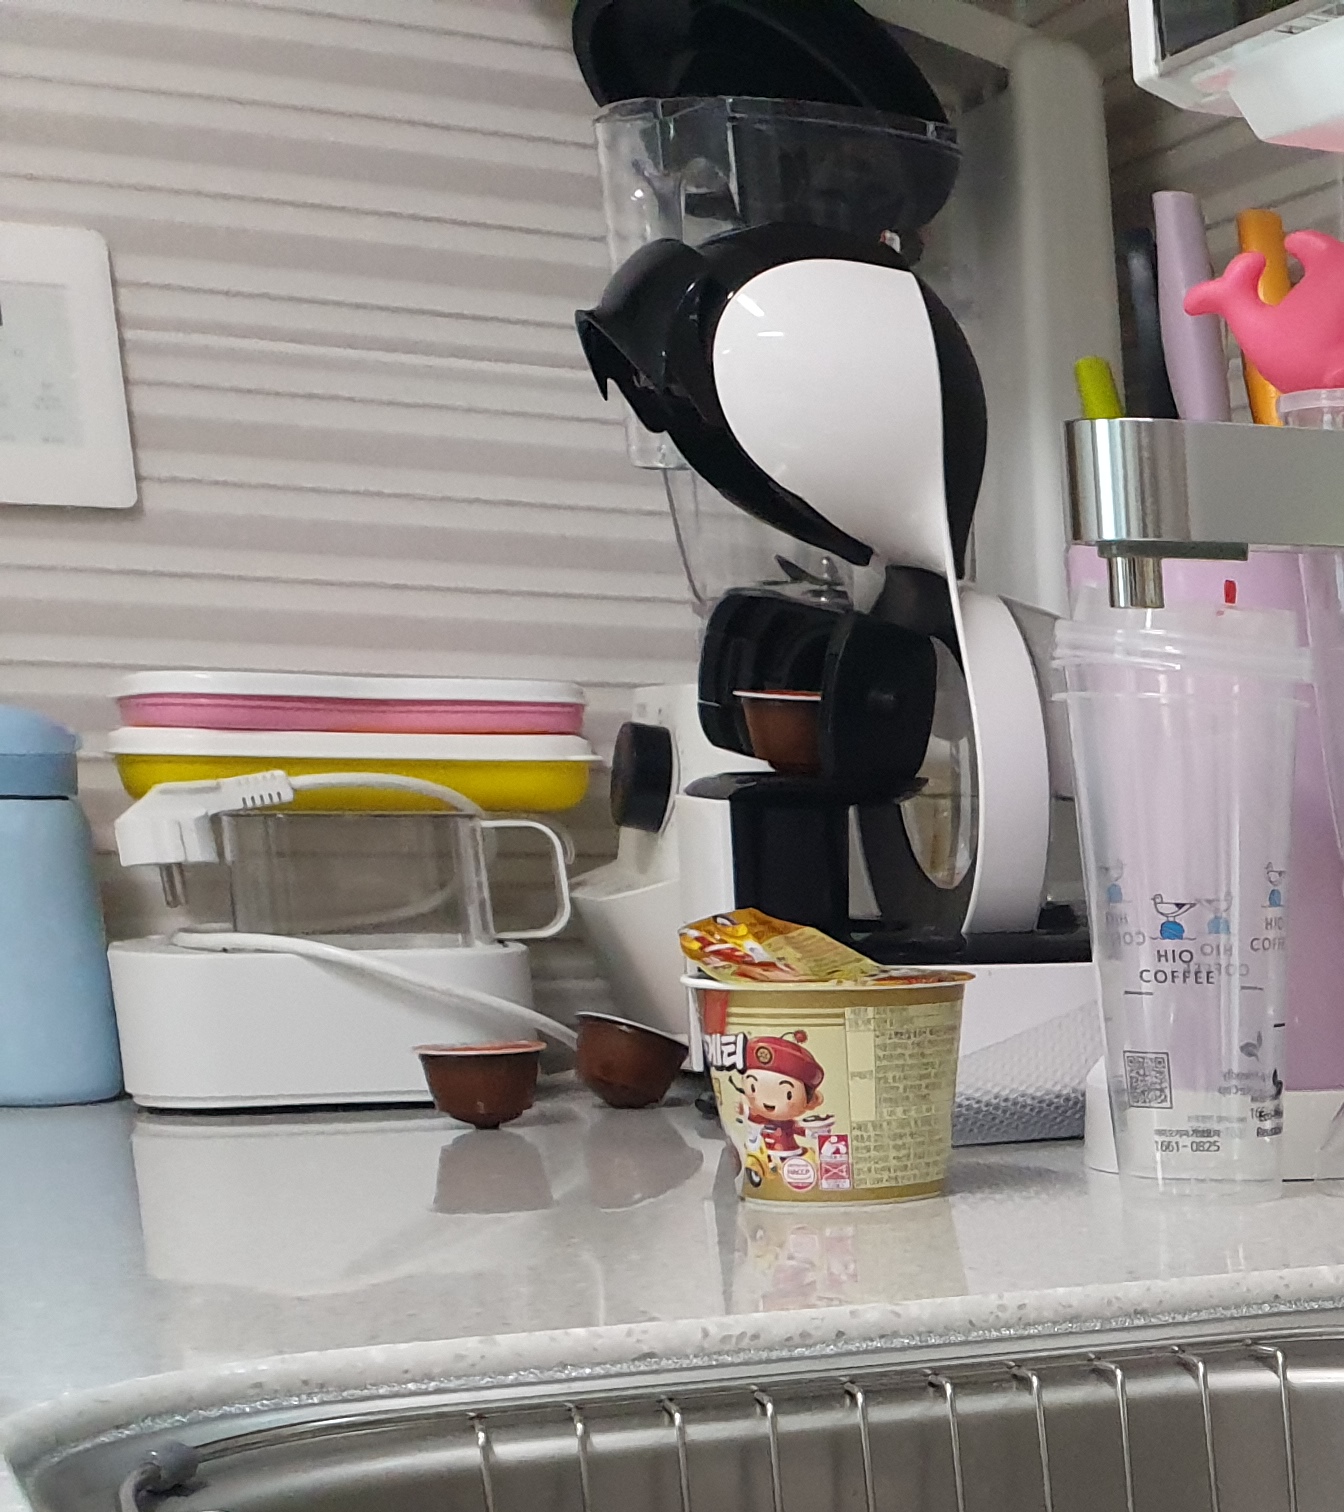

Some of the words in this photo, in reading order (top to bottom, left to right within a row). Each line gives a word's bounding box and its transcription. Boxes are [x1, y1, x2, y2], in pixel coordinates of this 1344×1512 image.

[1157, 949, 1194, 965] HIO
[1139, 969, 1216, 986] COFFEE
[1154, 1140, 1221, 1153] 1661-0825
